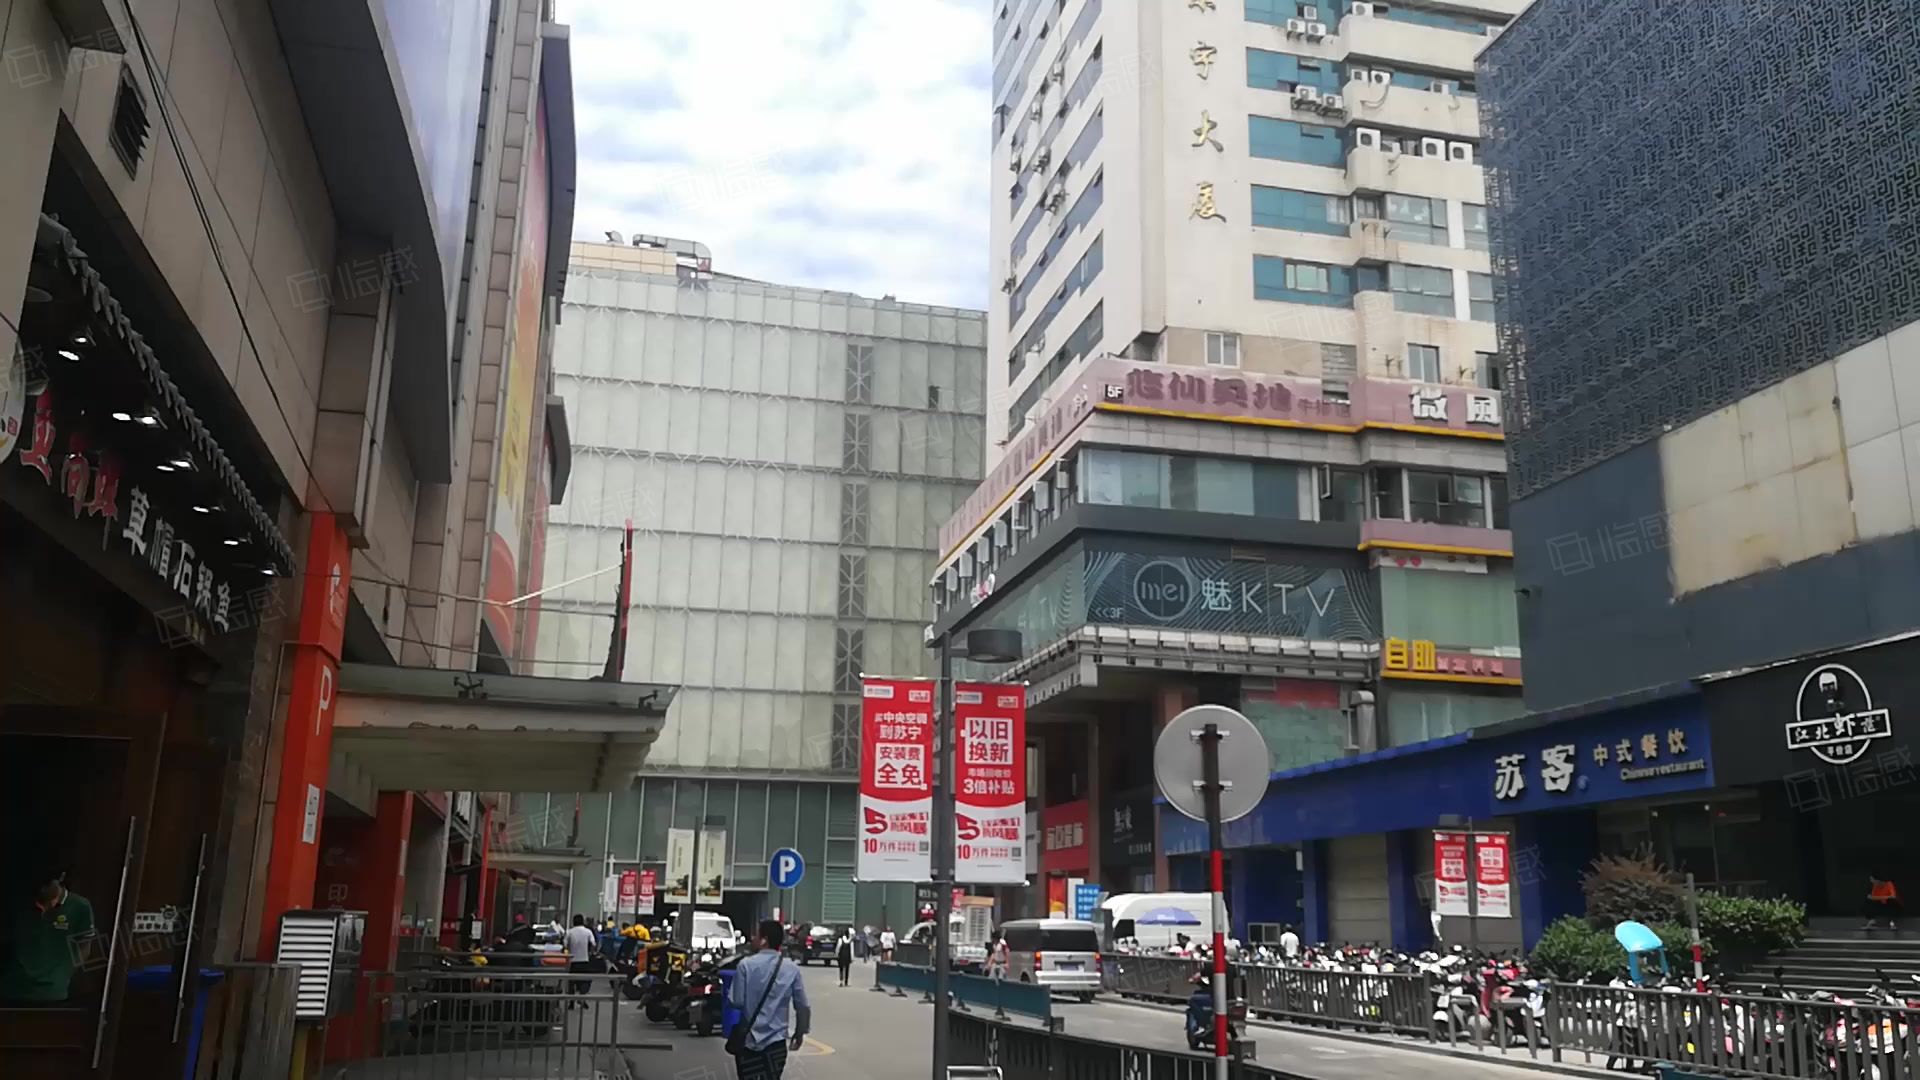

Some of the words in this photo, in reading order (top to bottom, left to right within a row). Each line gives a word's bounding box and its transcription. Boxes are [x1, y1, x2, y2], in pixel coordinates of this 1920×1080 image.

[1385, 636, 1436, 671] 自助
[879, 726, 922, 741] 到苏宁
[969, 719, 1009, 741] 以旧
[879, 747, 921, 761] 安装费
[968, 741, 1009, 762] 换新
[1592, 727, 1689, 767] 中式餐饮
[877, 762, 922, 786] 全免
[1494, 743, 1576, 800] 苏客
[962, 778, 1015, 795] 3倍补贴
[779, 855, 796, 883] P
